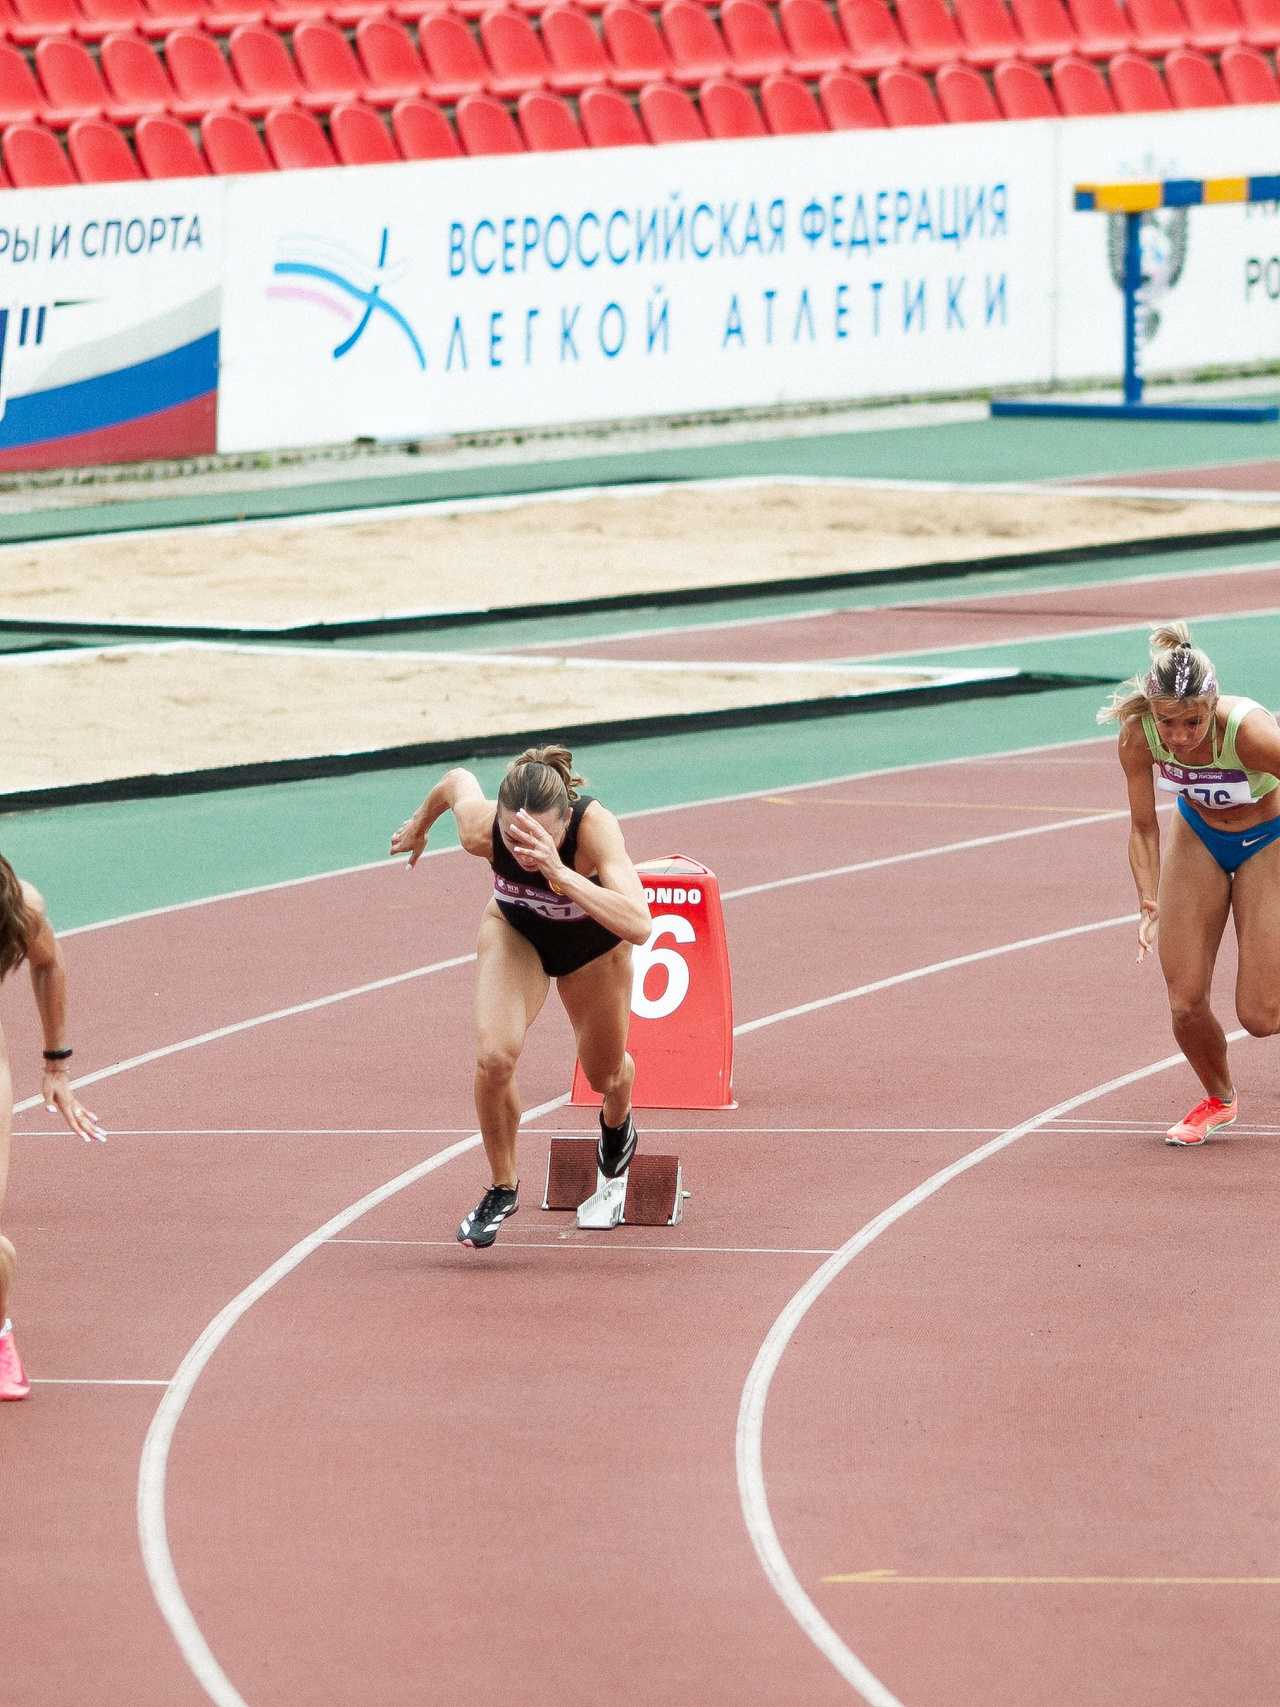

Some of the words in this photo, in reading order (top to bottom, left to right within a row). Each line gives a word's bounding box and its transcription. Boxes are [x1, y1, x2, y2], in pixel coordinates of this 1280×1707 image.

[50, 224, 71, 260] И
[81, 214, 204, 259] СПОРТА
[449, 190, 785, 278] ВСЕРОССИЙСКАЯ
[801, 182, 1008, 259] ФЕДЕРАЦИЯ
[445, 282, 669, 372] ЛЕГКОЙ
[721, 271, 1007, 350] АТЛЕТИКИ
[644, 887, 702, 905] ONDO
[630, 914, 697, 1019] 6
